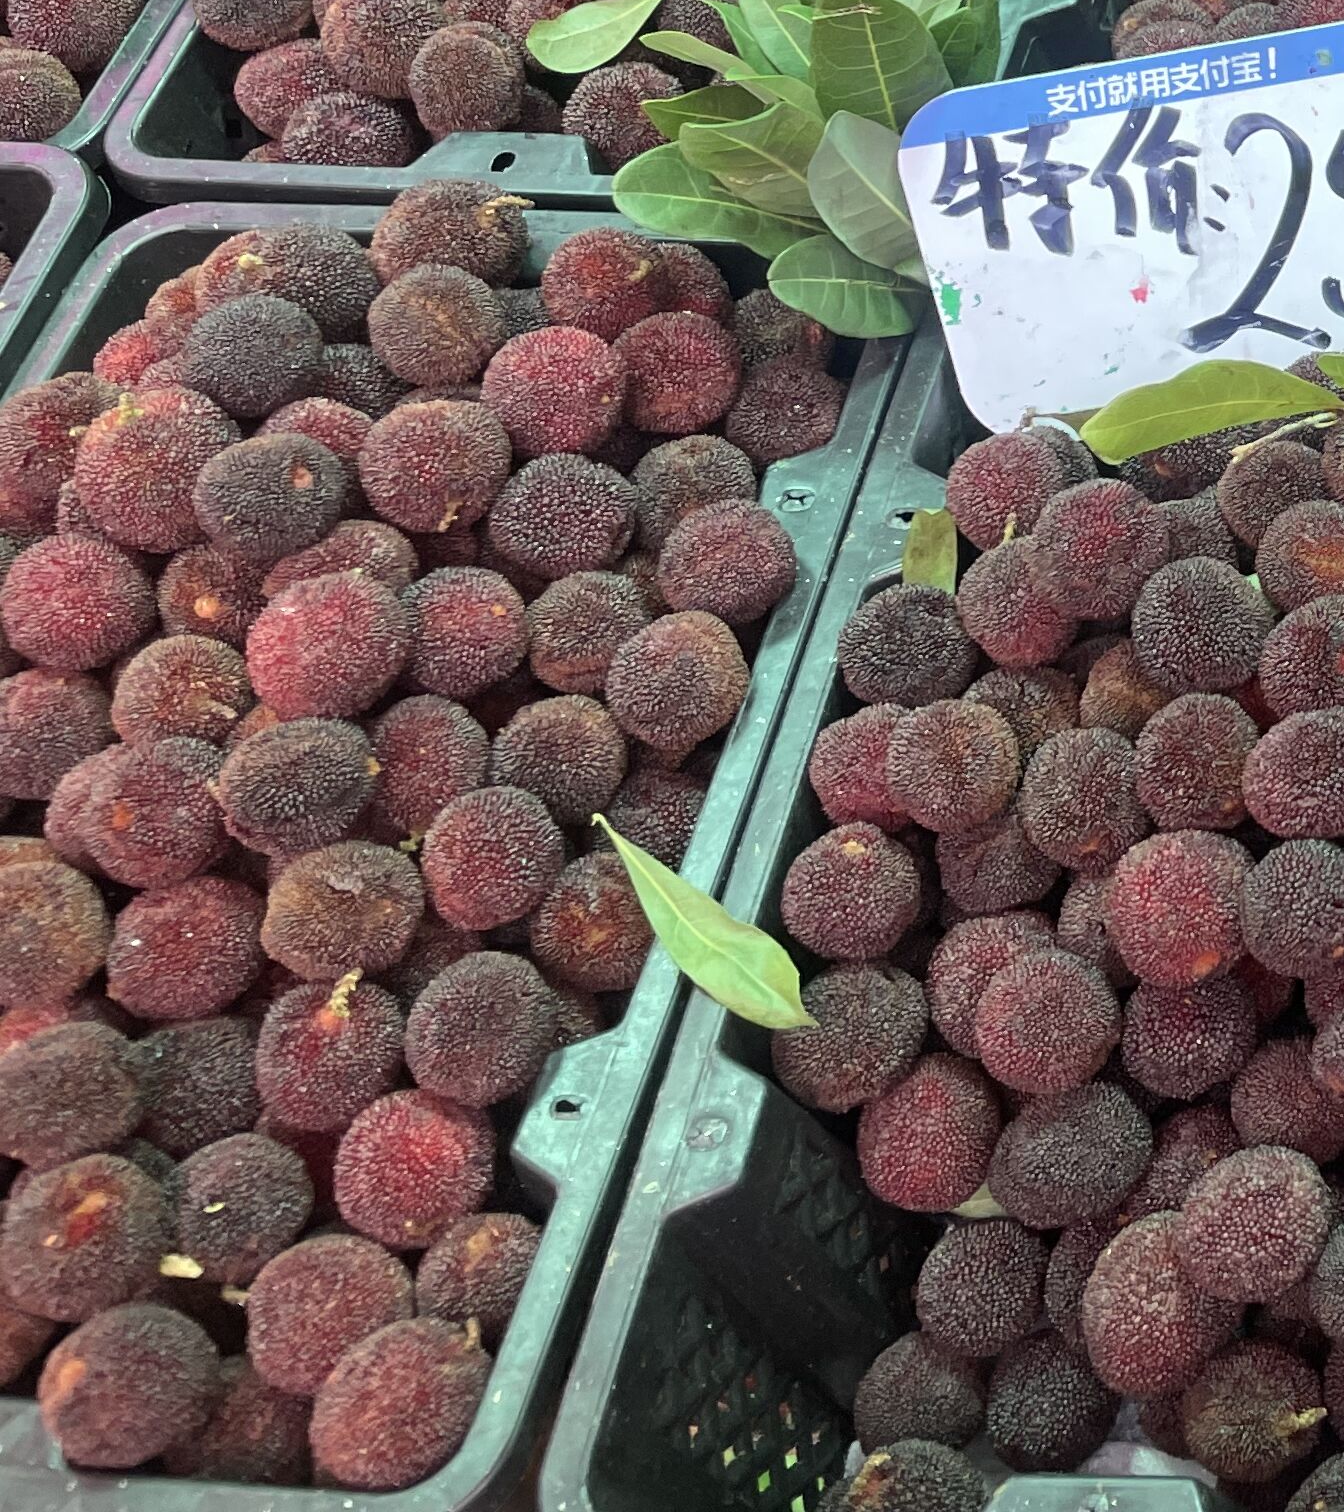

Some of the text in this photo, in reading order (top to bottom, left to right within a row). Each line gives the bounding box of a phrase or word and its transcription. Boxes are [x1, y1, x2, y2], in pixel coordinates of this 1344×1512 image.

[1046, 45, 1279, 118] 支付就用支付宝！
